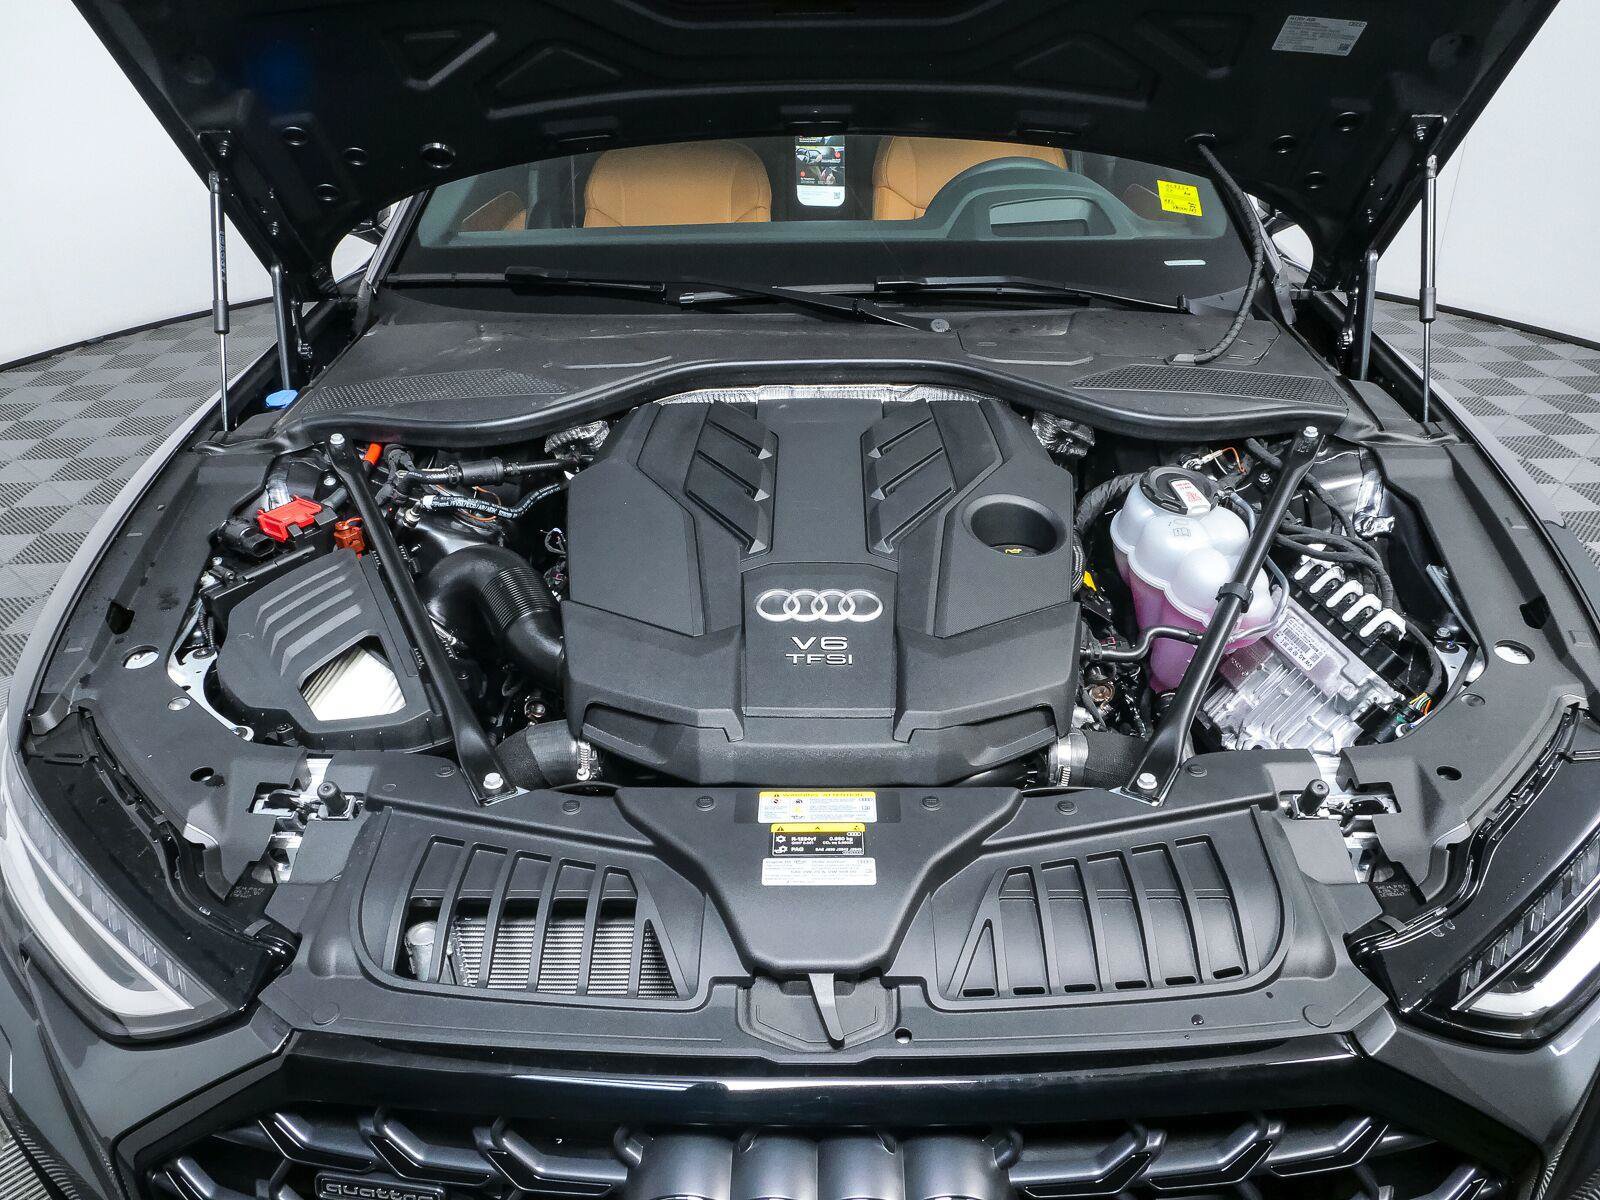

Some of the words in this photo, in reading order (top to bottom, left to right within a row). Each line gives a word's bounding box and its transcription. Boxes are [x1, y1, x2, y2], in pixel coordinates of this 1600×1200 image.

[791, 636, 848, 651] V6
[785, 653, 853, 666] TFSI
[325, 1182, 433, 1200] quattro
